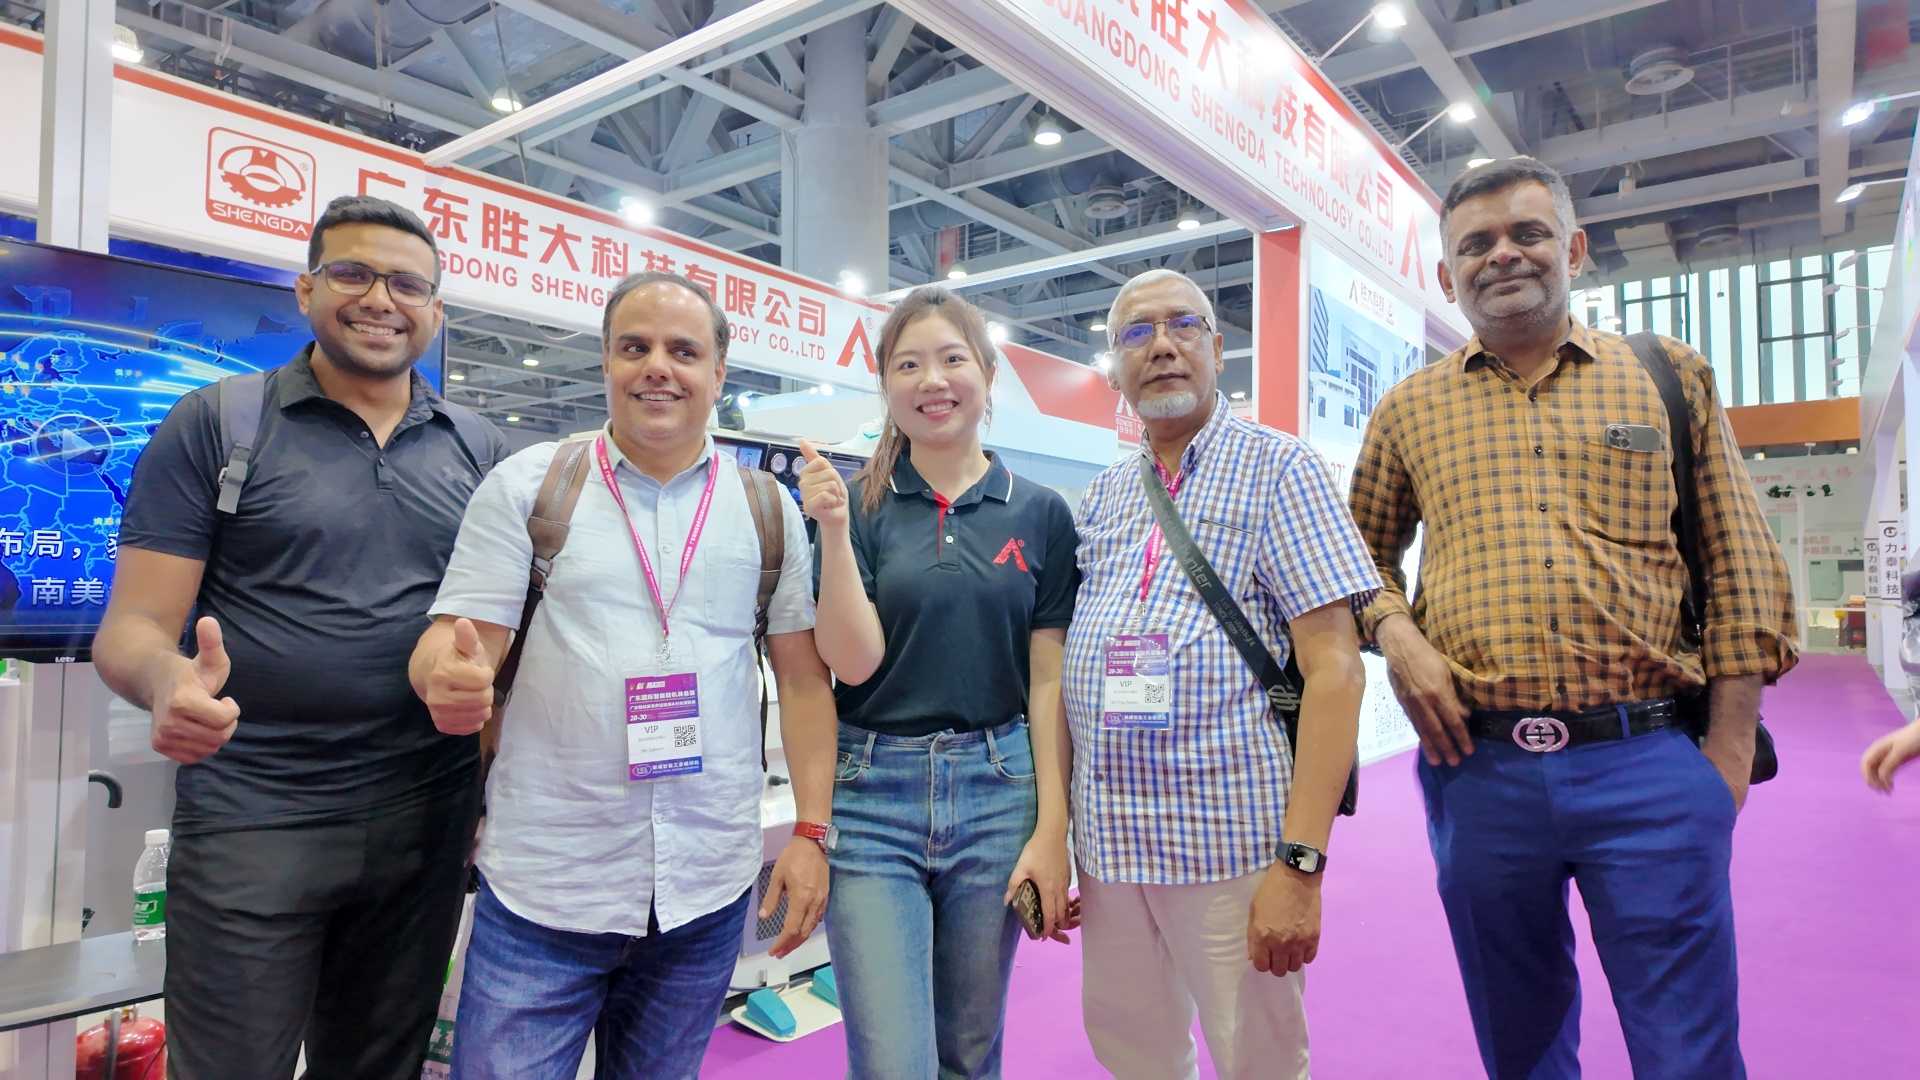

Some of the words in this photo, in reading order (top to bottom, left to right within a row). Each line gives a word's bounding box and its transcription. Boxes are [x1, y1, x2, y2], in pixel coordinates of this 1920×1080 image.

[1043, 0, 1180, 102] UANGDONG
[1191, 84, 1266, 169] SHENGDA
[1275, 151, 1353, 233] TECHNOLOGY
[1116, 0, 1393, 231] 胜大科技有限公司
[212, 203, 308, 236] SHENGDA
[531, 273, 614, 306] SHENG
[769, 333, 825, 361] CO.,LTD
[1116, 417, 1134, 428] SINCE
[1176, 541, 1213, 588] hunter
[1885, 543, 1899, 595] 力泰科技
[32, 577, 112, 606] 南美
[644, 725, 659, 733] VIP
